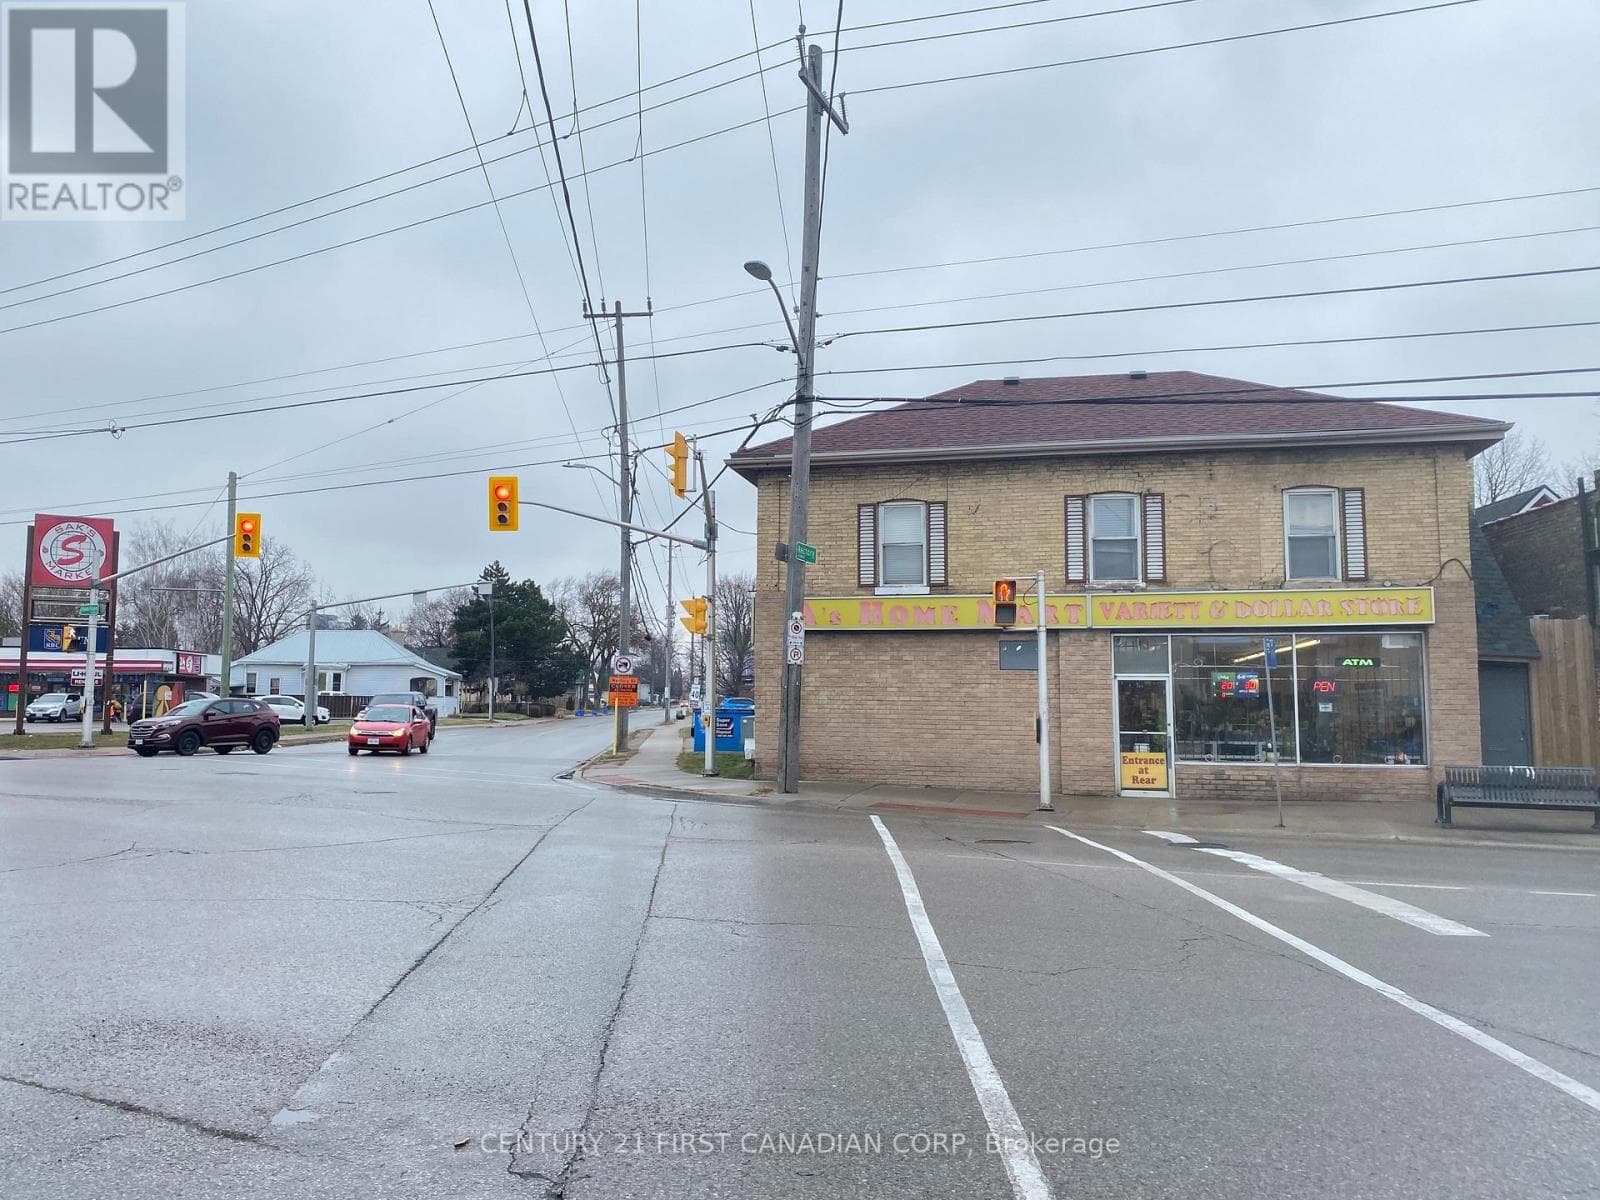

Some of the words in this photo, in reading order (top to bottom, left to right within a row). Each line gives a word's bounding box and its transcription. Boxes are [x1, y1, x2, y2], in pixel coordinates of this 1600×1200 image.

[55, 523, 96, 538] SAK'S
[46, 561, 93, 580] MARKE
[859, 600, 960, 626] HOME
[1099, 600, 1204, 621] VARIETY
[1208, 601, 1230, 620] &
[1235, 598, 1334, 619] DOLLAR
[1340, 596, 1424, 617] STORE
[1342, 658, 1374, 666] ATM
[1122, 755, 1165, 765] Entrance
[1138, 766, 1149, 775] at
[1131, 775, 1157, 785] Rear
